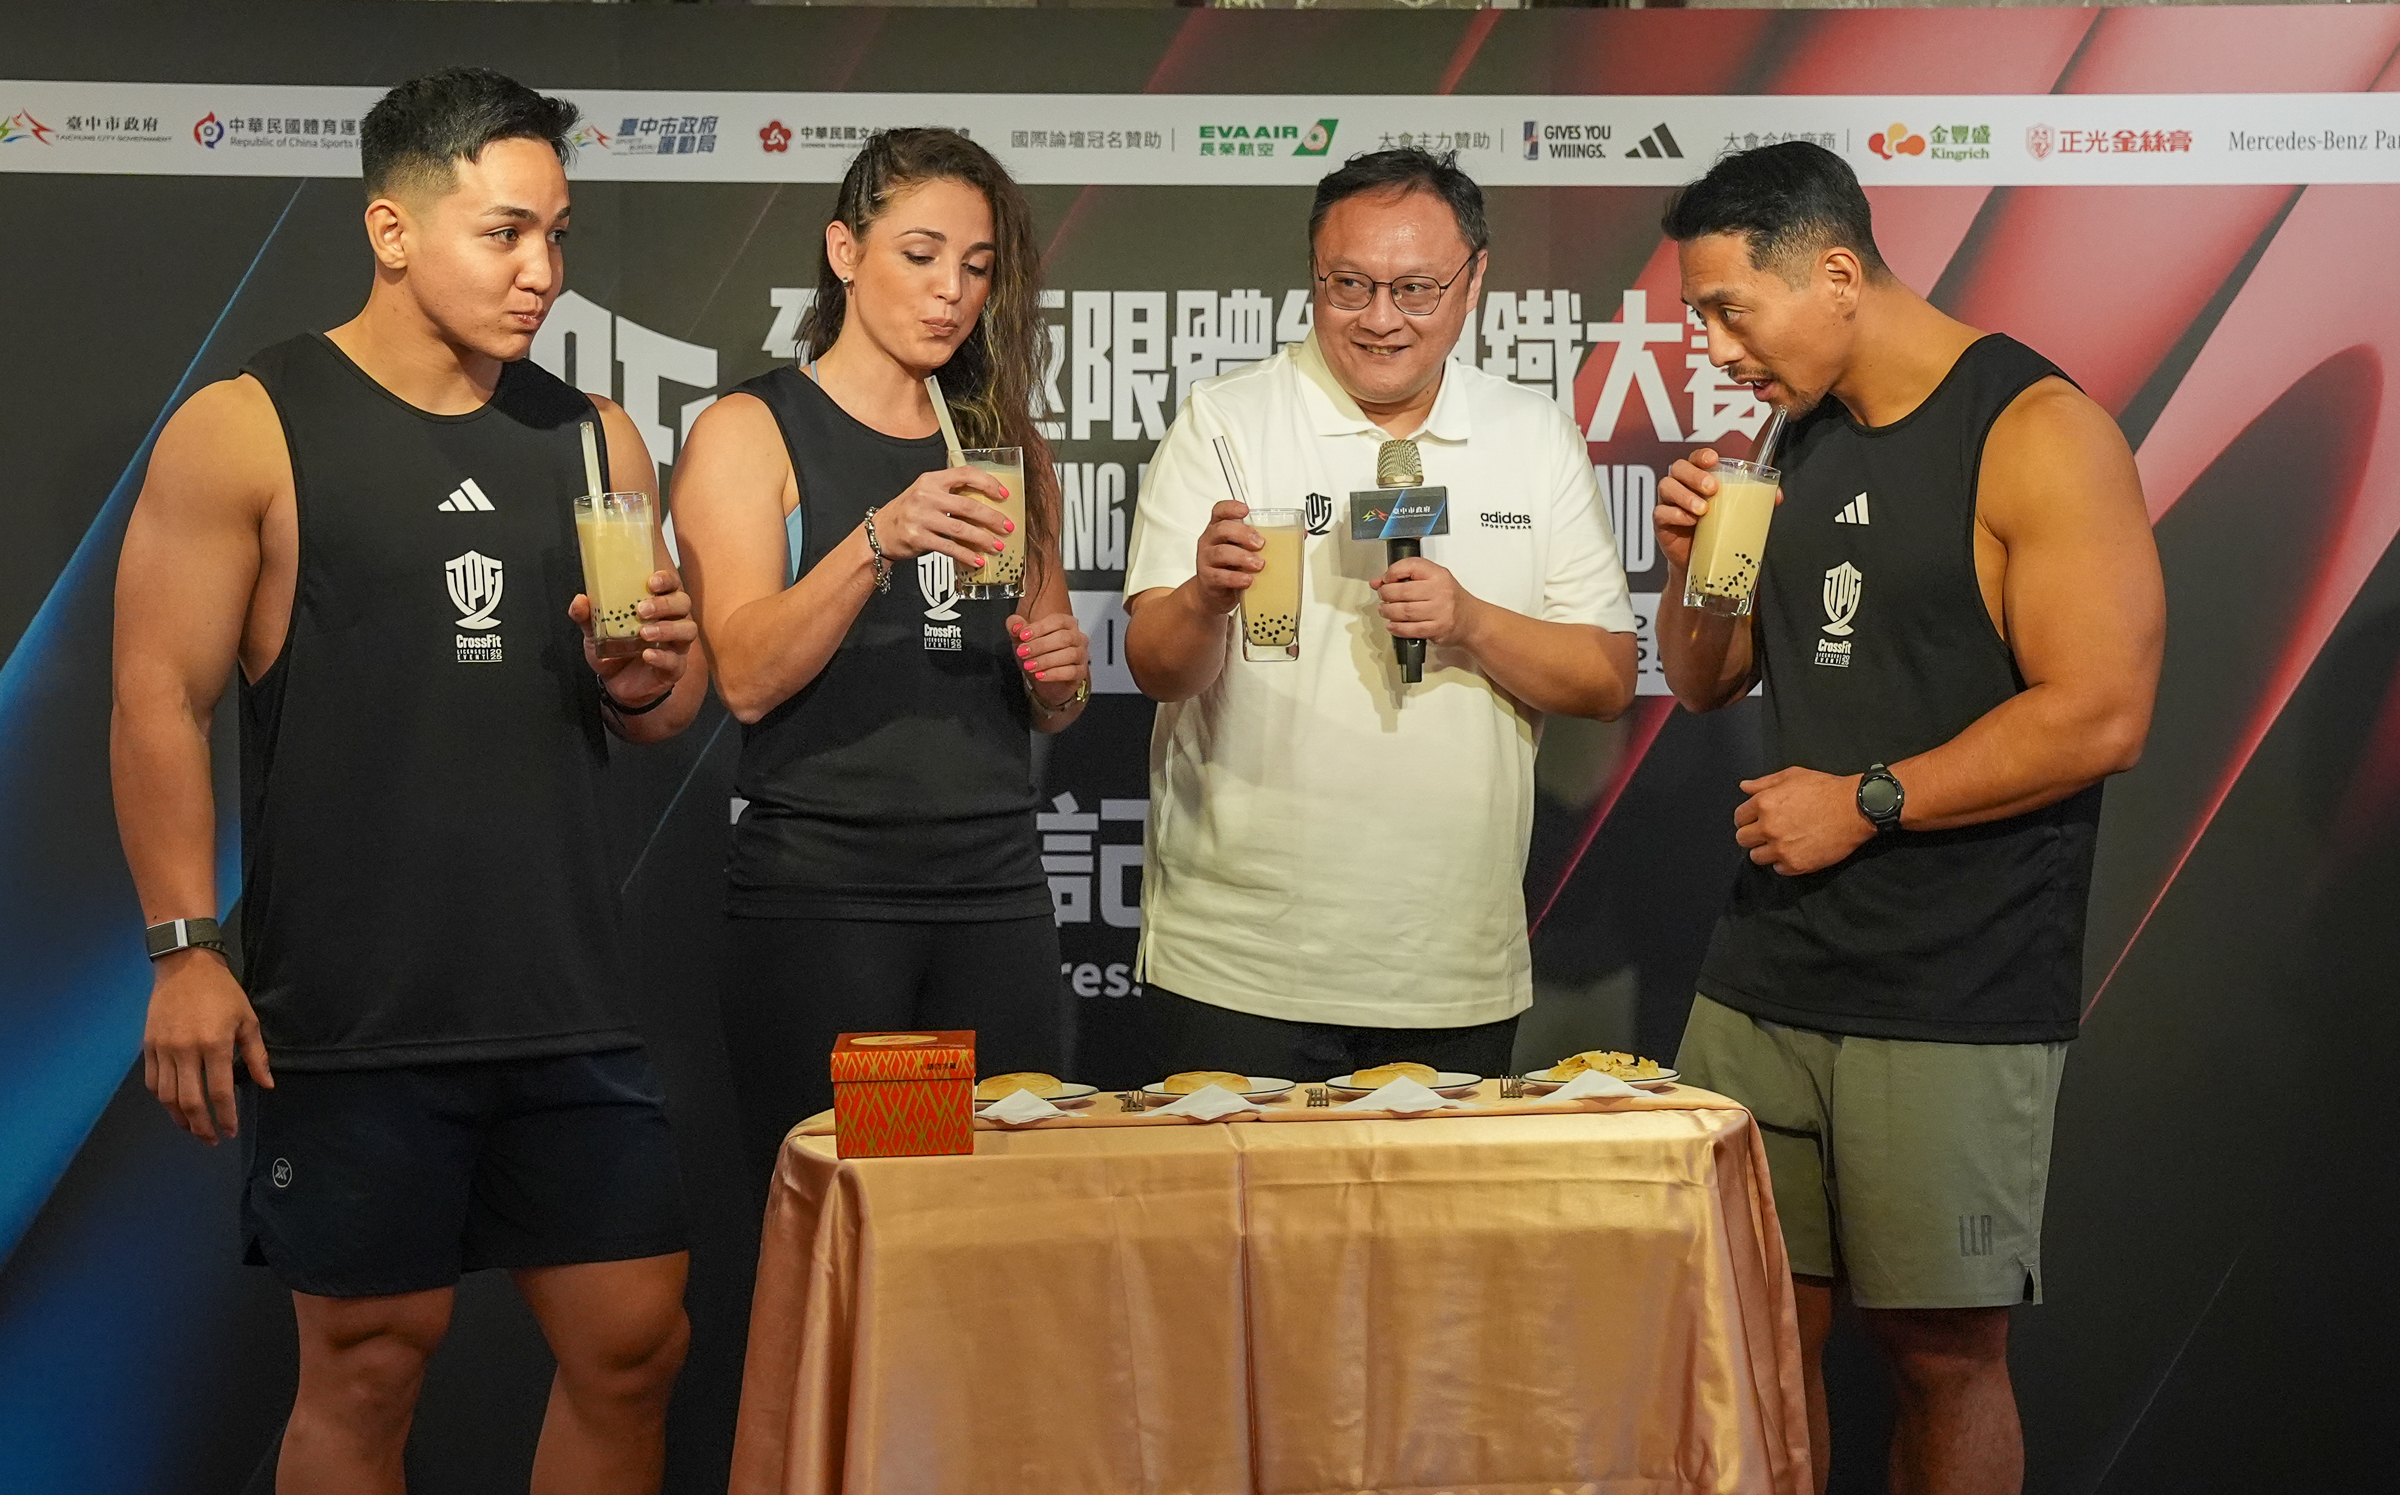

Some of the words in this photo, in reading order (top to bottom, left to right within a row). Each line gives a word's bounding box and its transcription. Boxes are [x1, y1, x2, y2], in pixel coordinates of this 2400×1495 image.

[66, 116, 158, 131] 臺中市政府
[229, 117, 365, 135] 中華民國體育運
[1544, 125, 1581, 140] GIVES
[1585, 125, 1612, 140] YOU
[1929, 124, 1991, 145] 金豐盛
[2228, 129, 2368, 151] Mercedes-Benz
[230, 136, 274, 148] Republic
[276, 137, 287, 147] of
[288, 137, 318, 147] China
[320, 138, 354, 149] Sports
[1199, 142, 1274, 157] 長榮航空
[2058, 130, 2192, 154] 正光金絲膏
[1930, 147, 1990, 162] Kingrich
[1480, 511, 1531, 524] adidas
[1481, 522, 1532, 530] SPORTSWEAR
[924, 623, 962, 638] CrossFit
[456, 634, 502, 648] CrossFit
[1817, 638, 1851, 655] CrossFit
